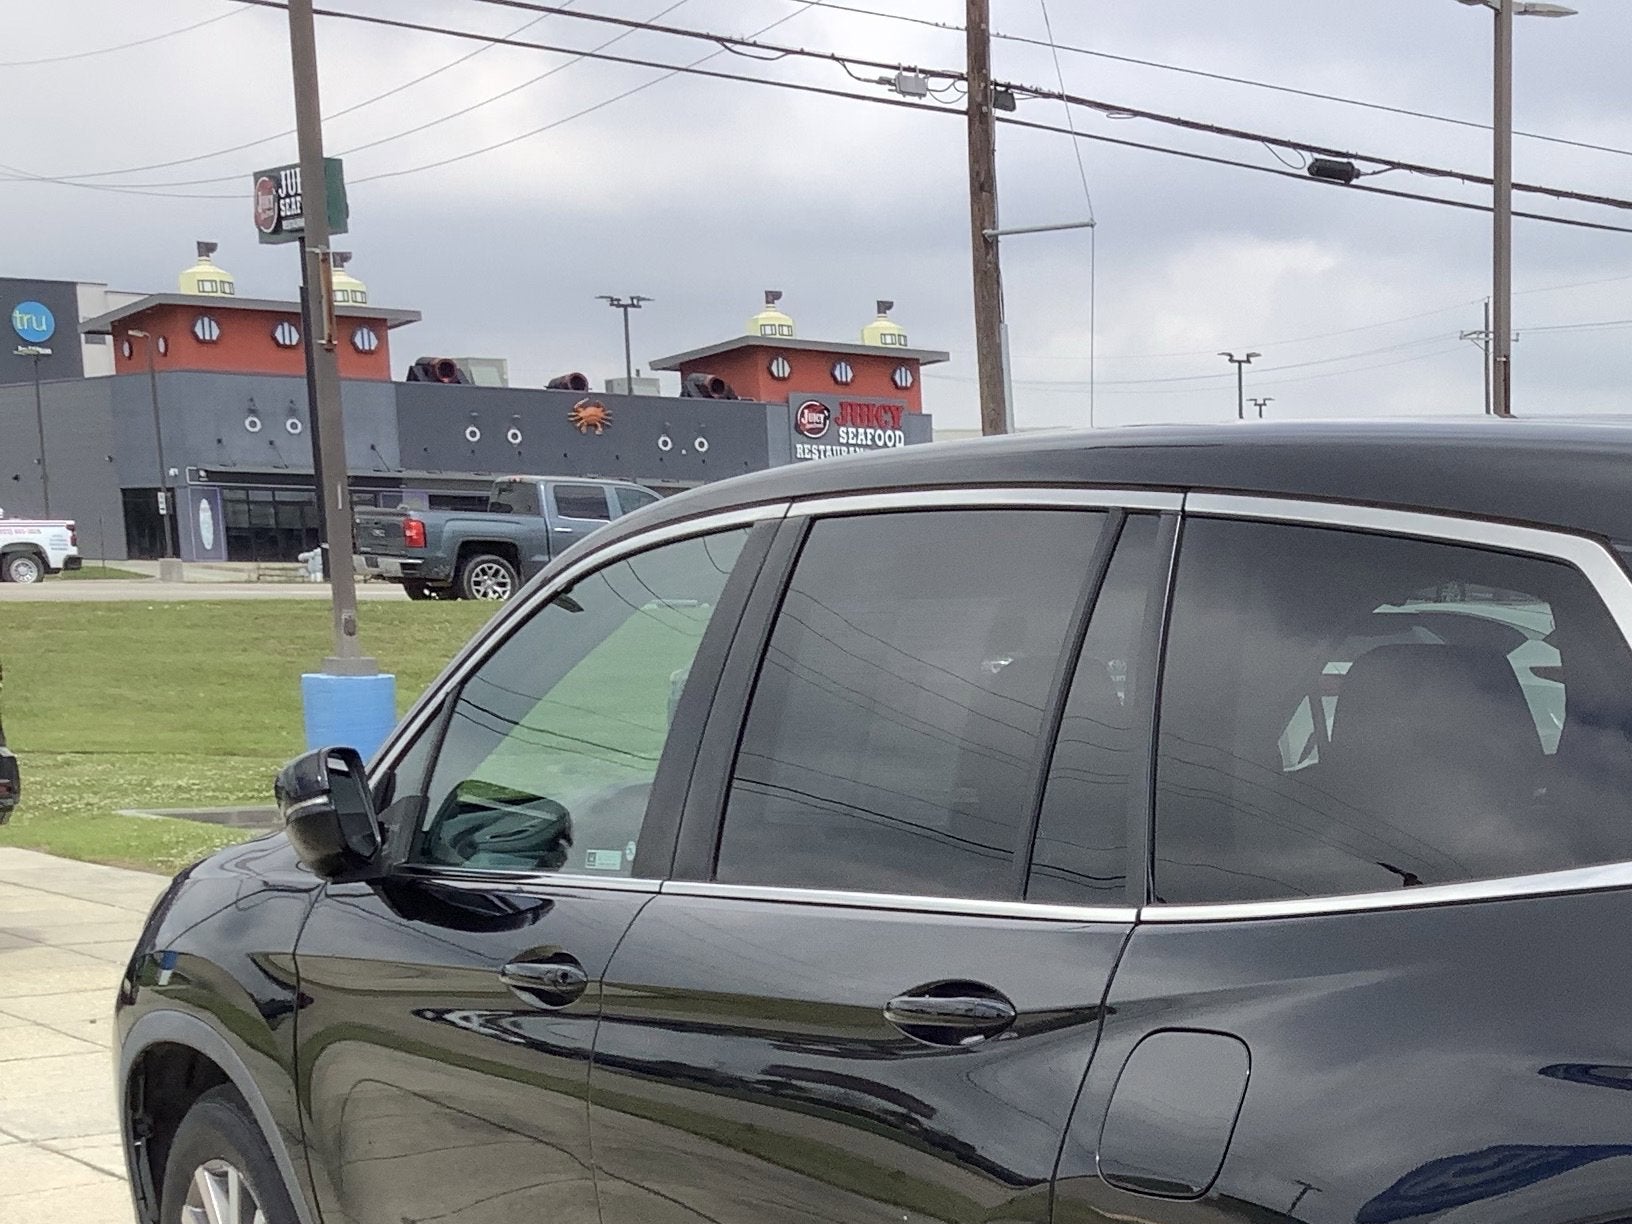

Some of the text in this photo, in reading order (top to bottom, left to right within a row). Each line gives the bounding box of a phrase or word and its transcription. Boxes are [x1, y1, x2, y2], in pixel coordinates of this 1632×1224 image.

[12, 310, 47, 331] tru
[835, 401, 904, 429] JUICY
[839, 427, 905, 448] SEAFOOD
